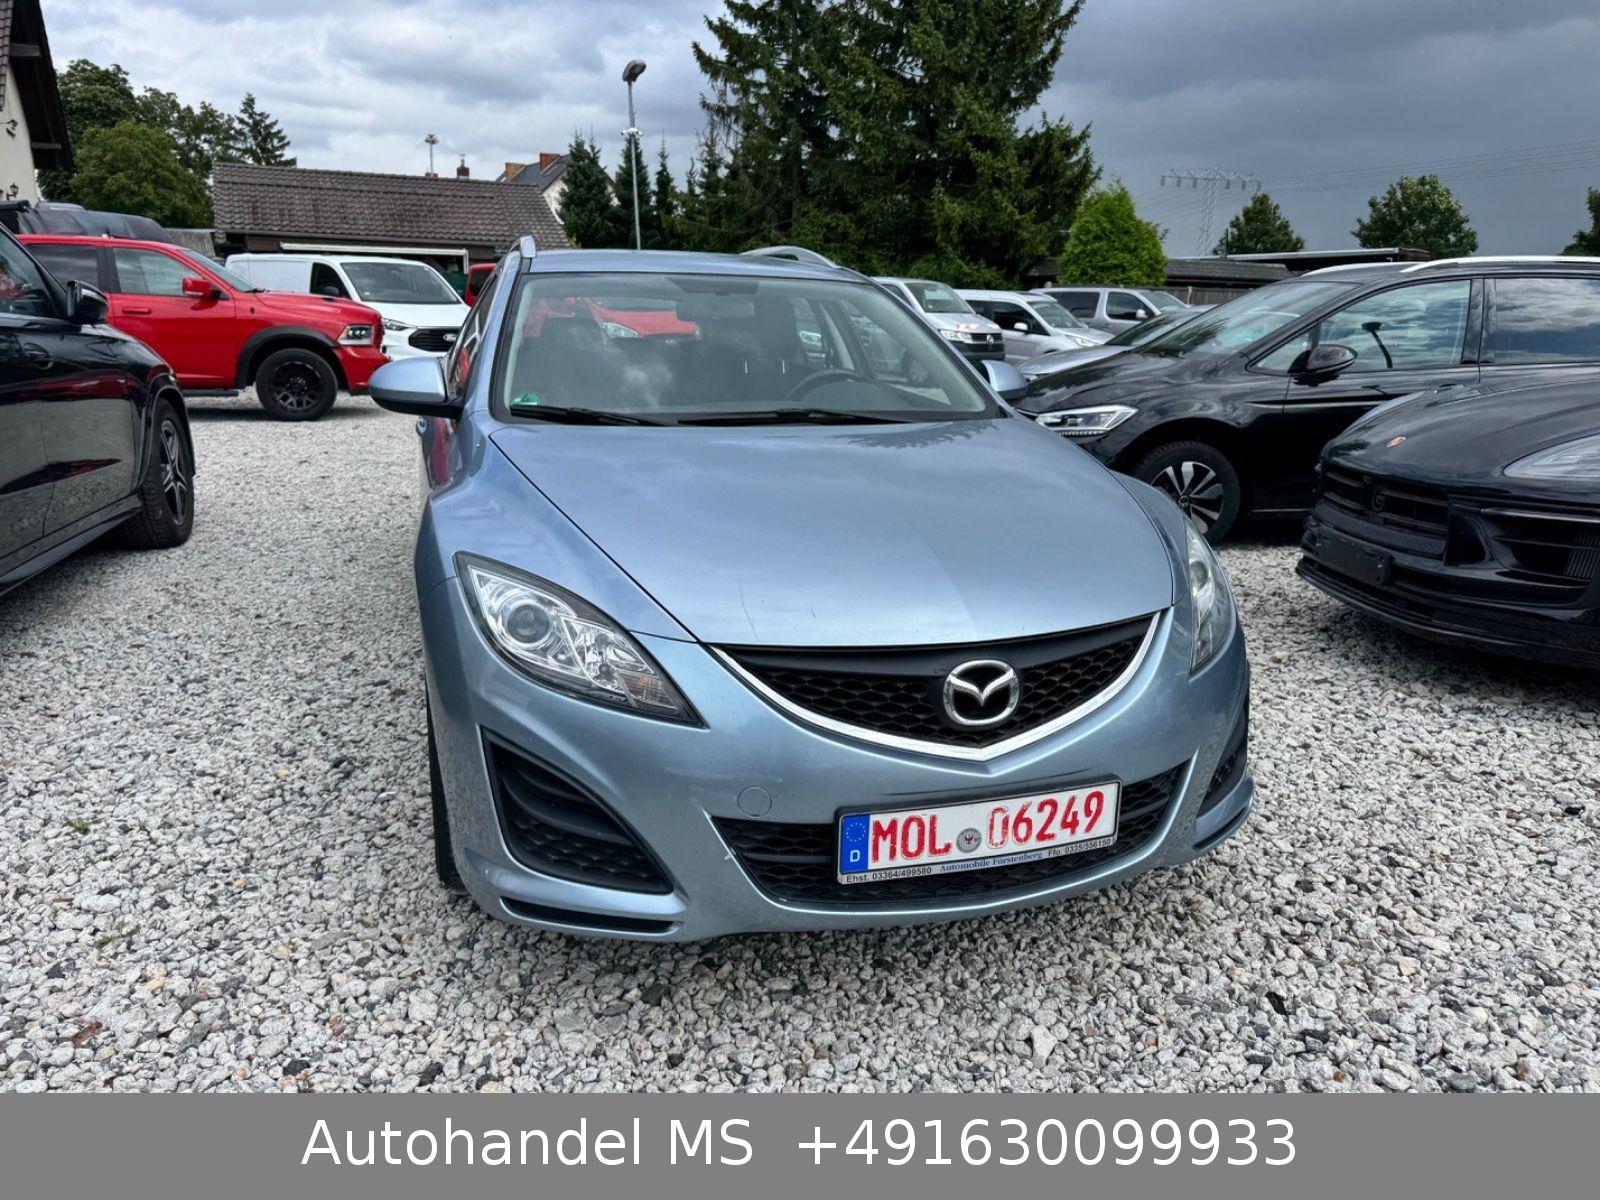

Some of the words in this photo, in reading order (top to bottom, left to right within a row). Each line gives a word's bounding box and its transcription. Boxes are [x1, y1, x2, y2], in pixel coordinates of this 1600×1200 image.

[872, 814, 952, 863] MOL
[988, 790, 1105, 849] 06249
[850, 850, 860, 862] D
